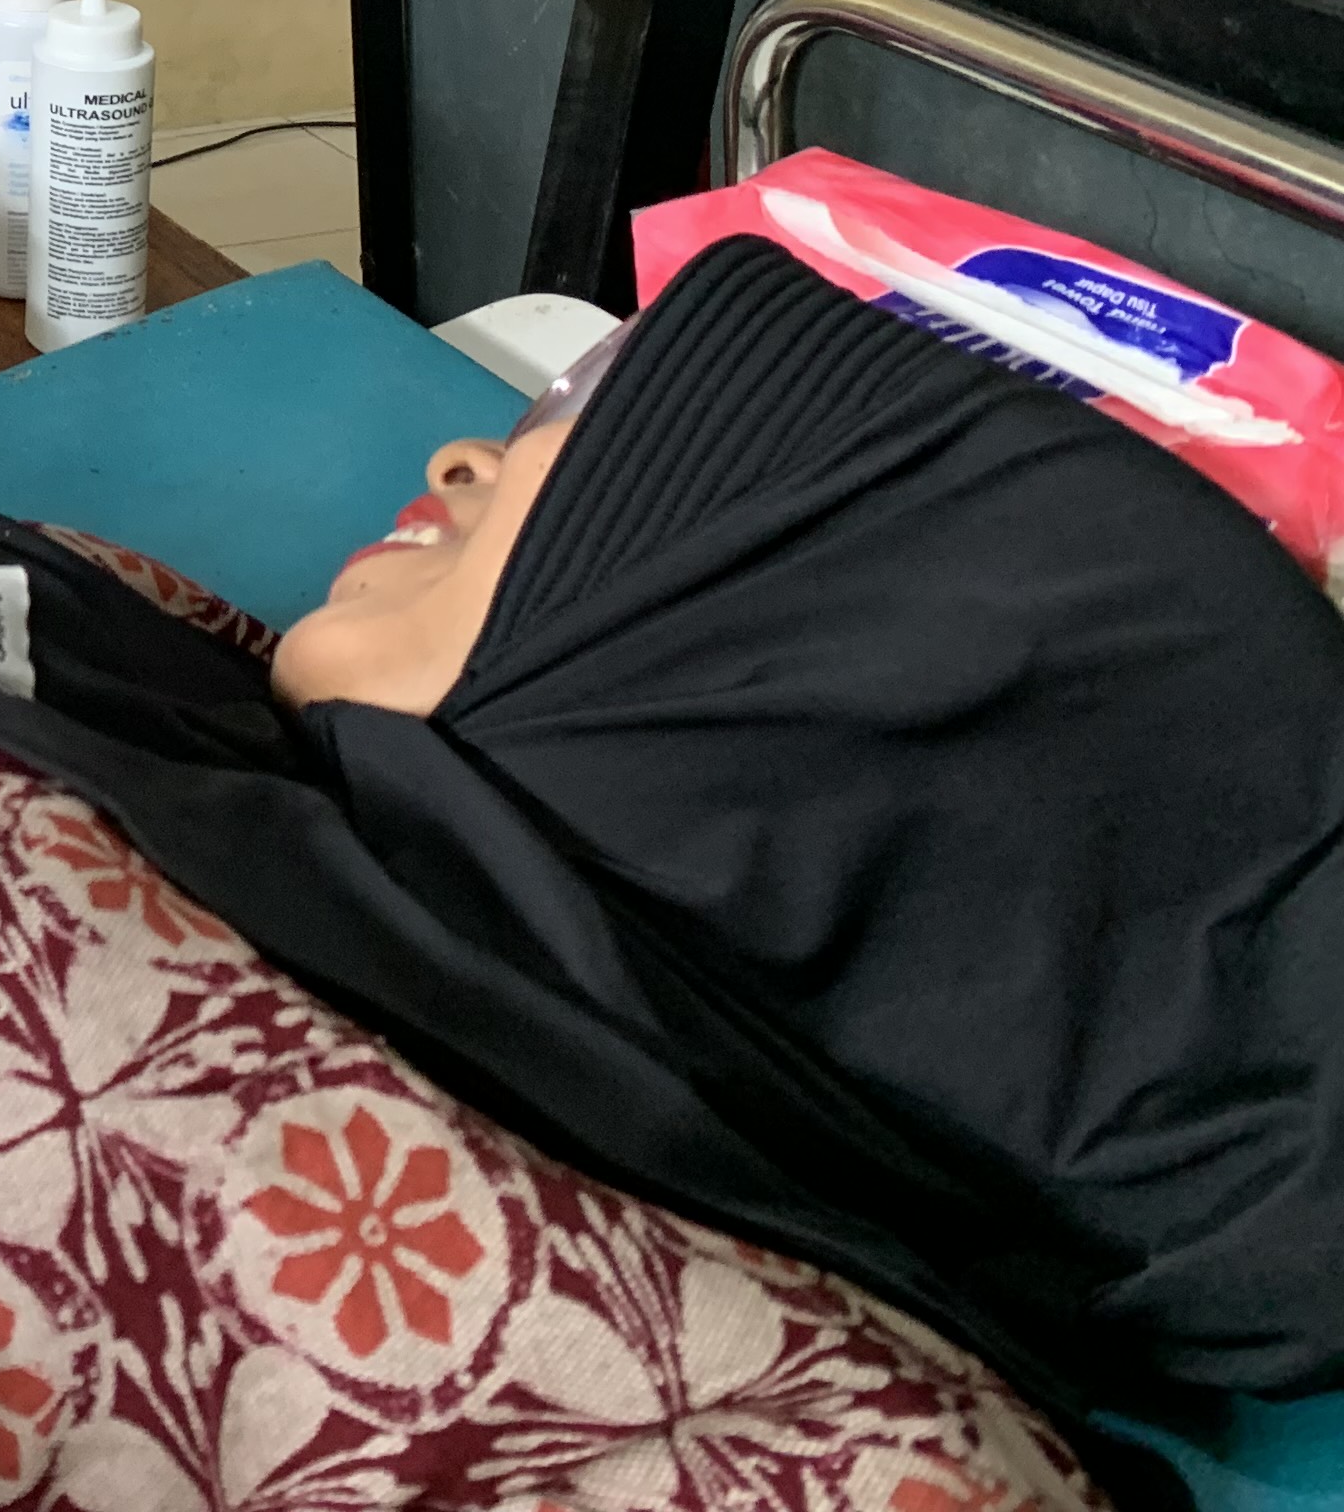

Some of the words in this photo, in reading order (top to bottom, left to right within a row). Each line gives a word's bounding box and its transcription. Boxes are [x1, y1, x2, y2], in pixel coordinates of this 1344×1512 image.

[84, 88, 147, 106] MEDICAL
[50, 102, 148, 122] ULTRASOUND
[1073, 277, 1126, 306] Dapur
[1125, 295, 1157, 320] Tisu
